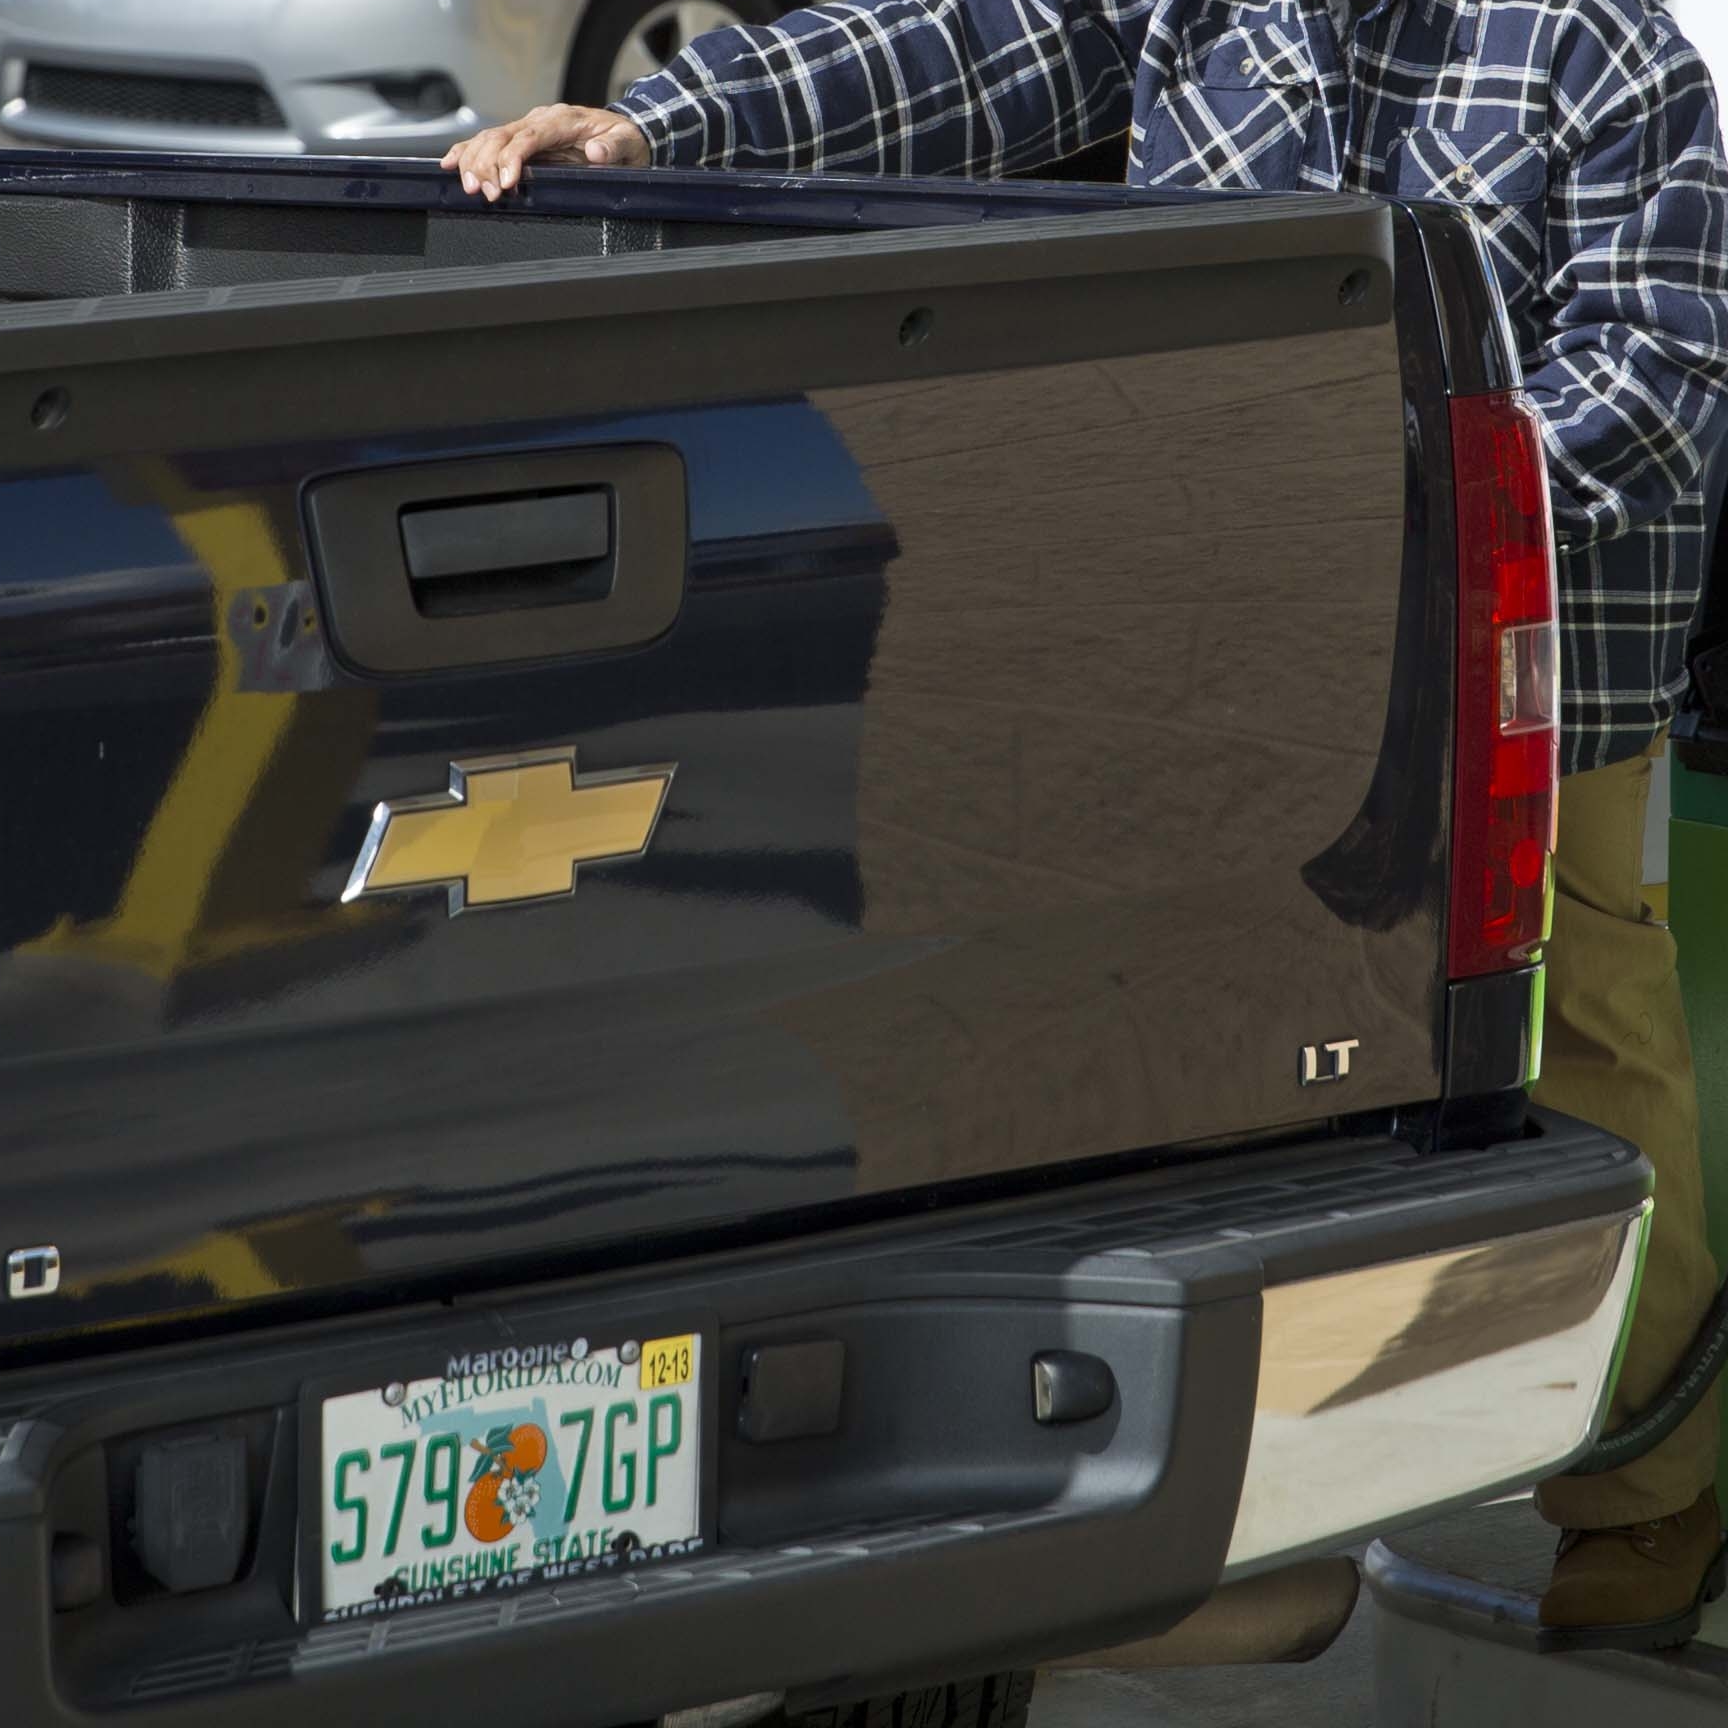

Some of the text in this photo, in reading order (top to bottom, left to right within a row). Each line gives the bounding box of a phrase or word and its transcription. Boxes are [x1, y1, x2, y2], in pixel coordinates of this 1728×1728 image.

[1302, 1039, 1359, 1086] LT
[447, 1340, 569, 1380] Maroone
[648, 1348, 690, 1385] 12-13
[400, 1361, 623, 1430] MYFLORIDA.COM
[330, 1392, 683, 1566] S79 7GP
[394, 1527, 614, 1592] SUNSHINE STATE
